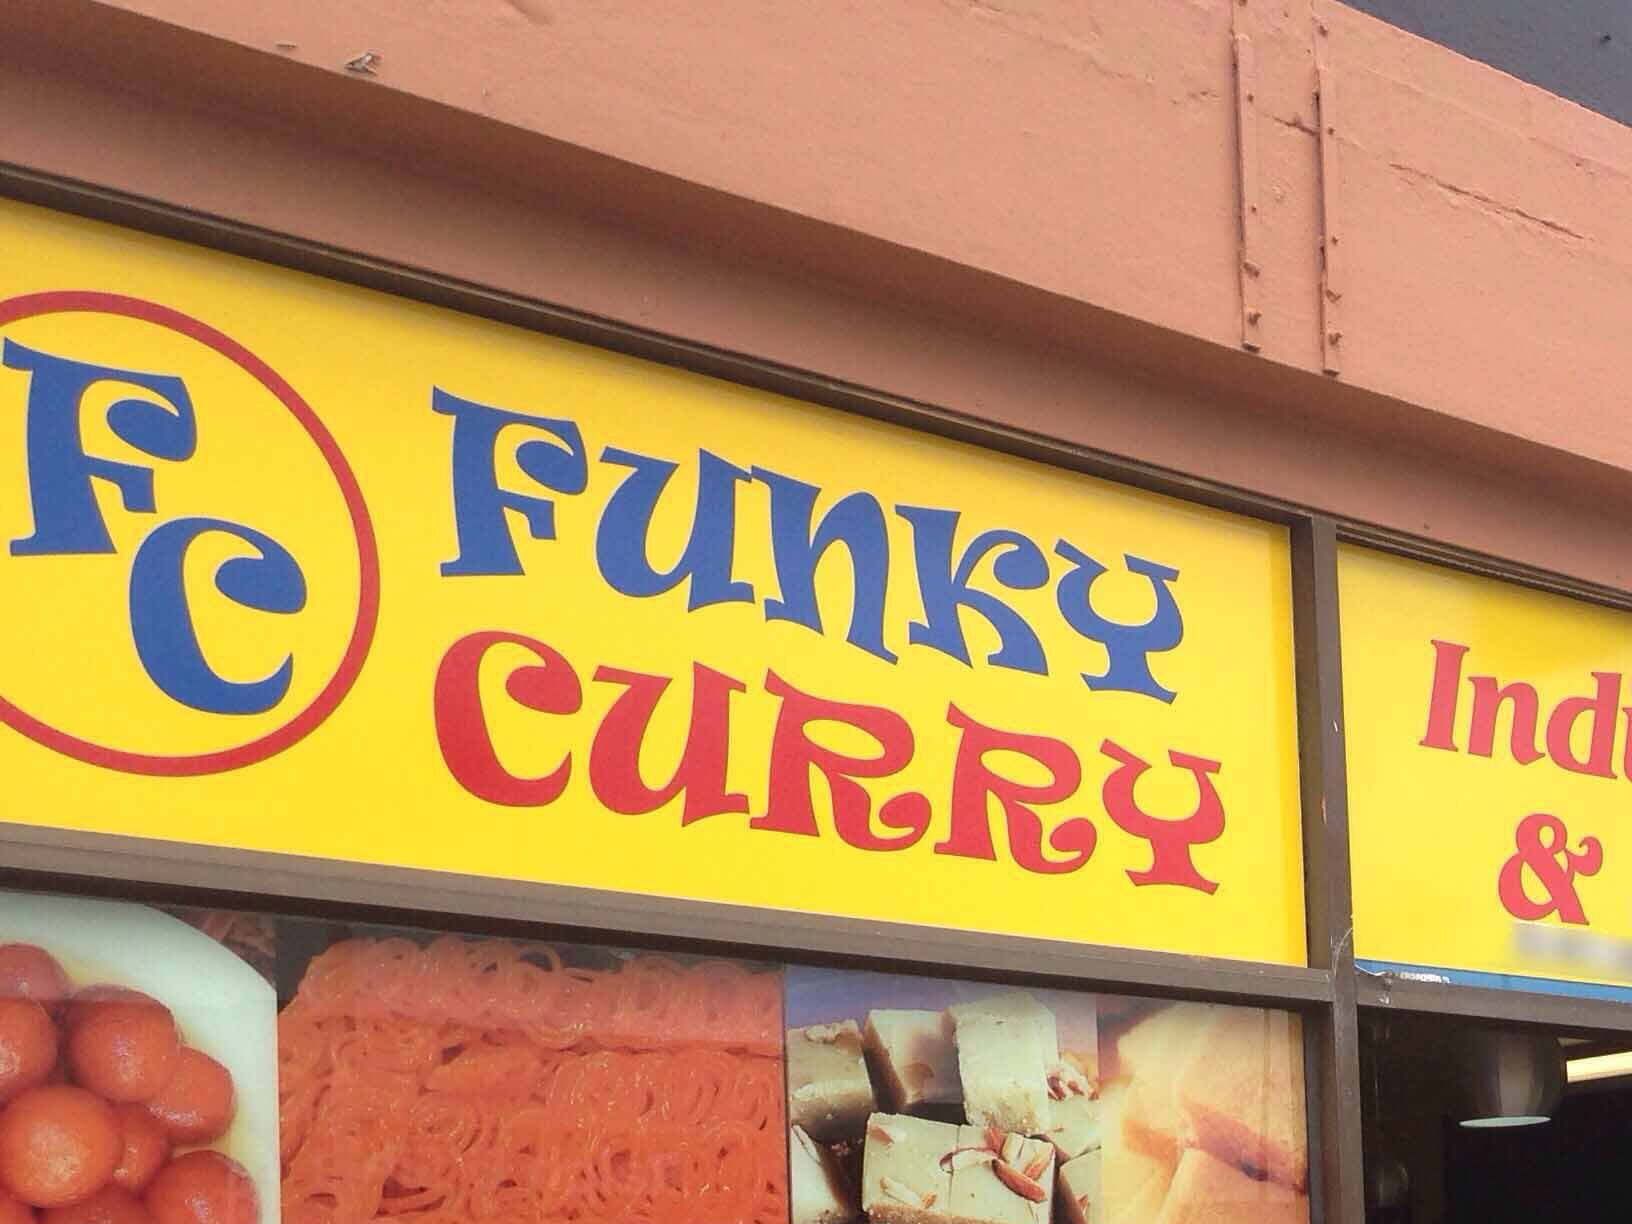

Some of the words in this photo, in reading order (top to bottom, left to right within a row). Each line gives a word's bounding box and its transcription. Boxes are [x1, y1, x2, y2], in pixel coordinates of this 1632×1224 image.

[432, 385, 1184, 704] FUNKY
[433, 630, 1226, 896] CURRY
[1498, 813, 1603, 925] &
